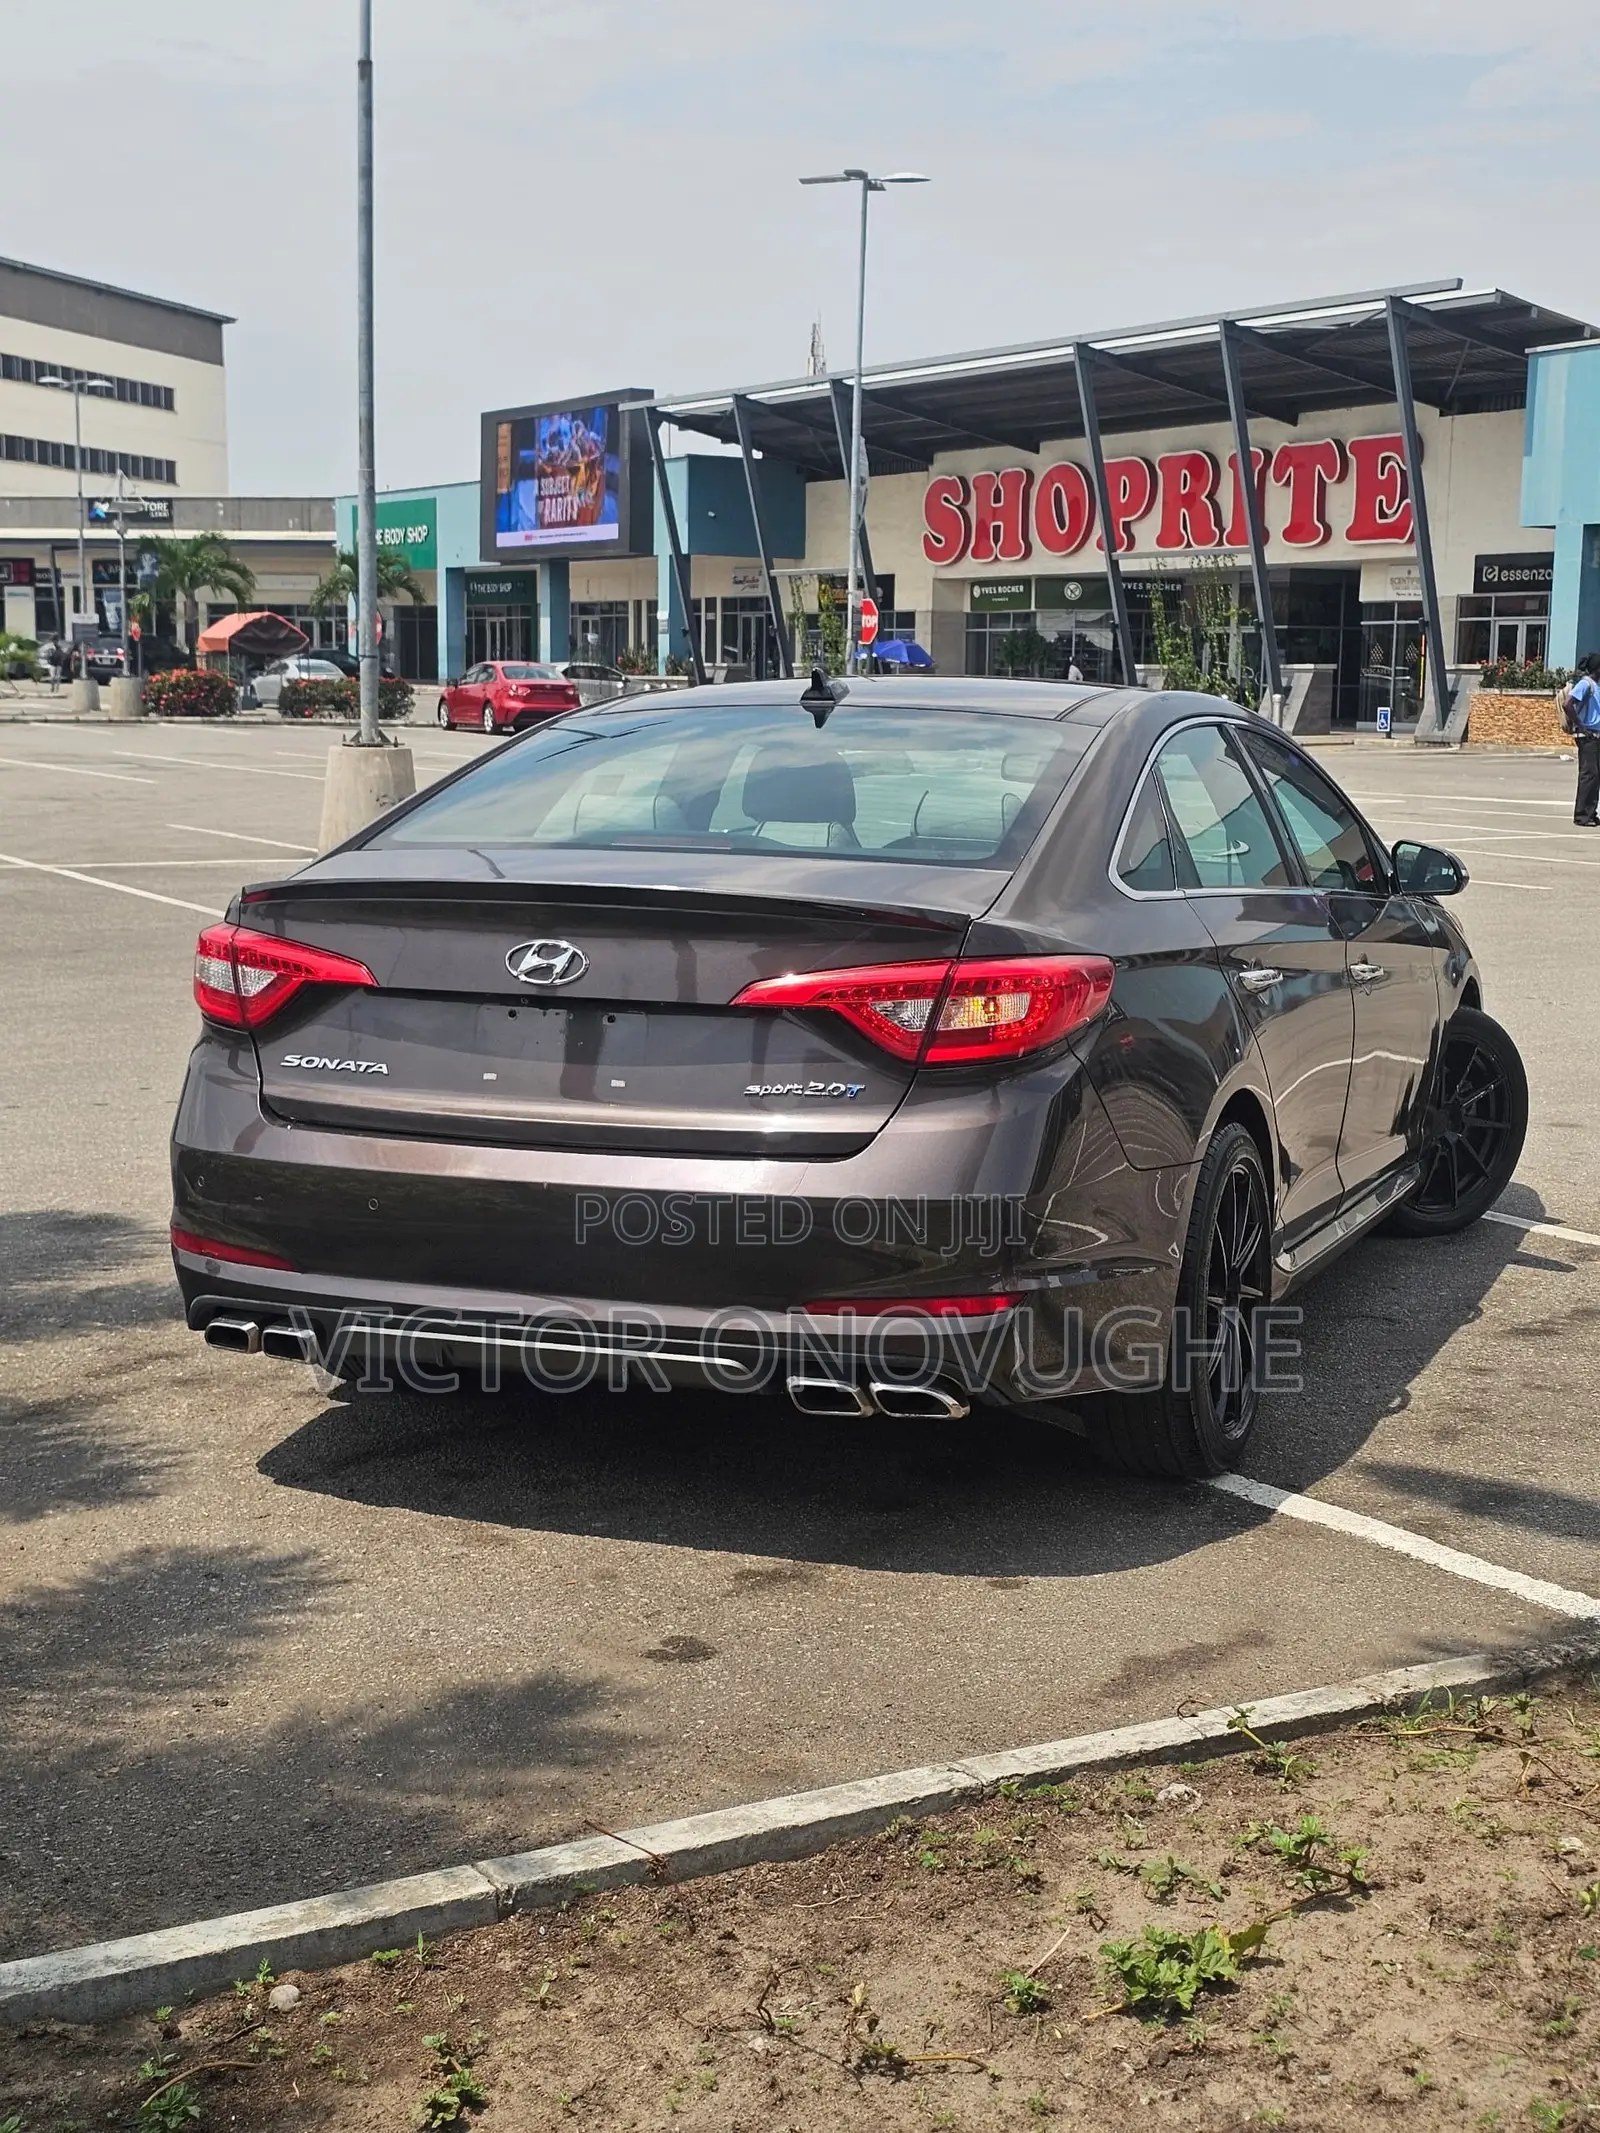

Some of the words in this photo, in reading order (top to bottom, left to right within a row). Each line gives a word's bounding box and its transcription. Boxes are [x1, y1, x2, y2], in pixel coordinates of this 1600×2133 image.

[922, 432, 1421, 566] SHOPRITE
[384, 526, 406, 545] BODY
[406, 524, 429, 543] SHOP
[981, 586, 997, 594] YVES
[997, 584, 1025, 594] ROCHER
[1121, 582, 1144, 590] YVES
[1145, 582, 1182, 591] ROCHER
[280, 1054, 389, 1075] SONATA
